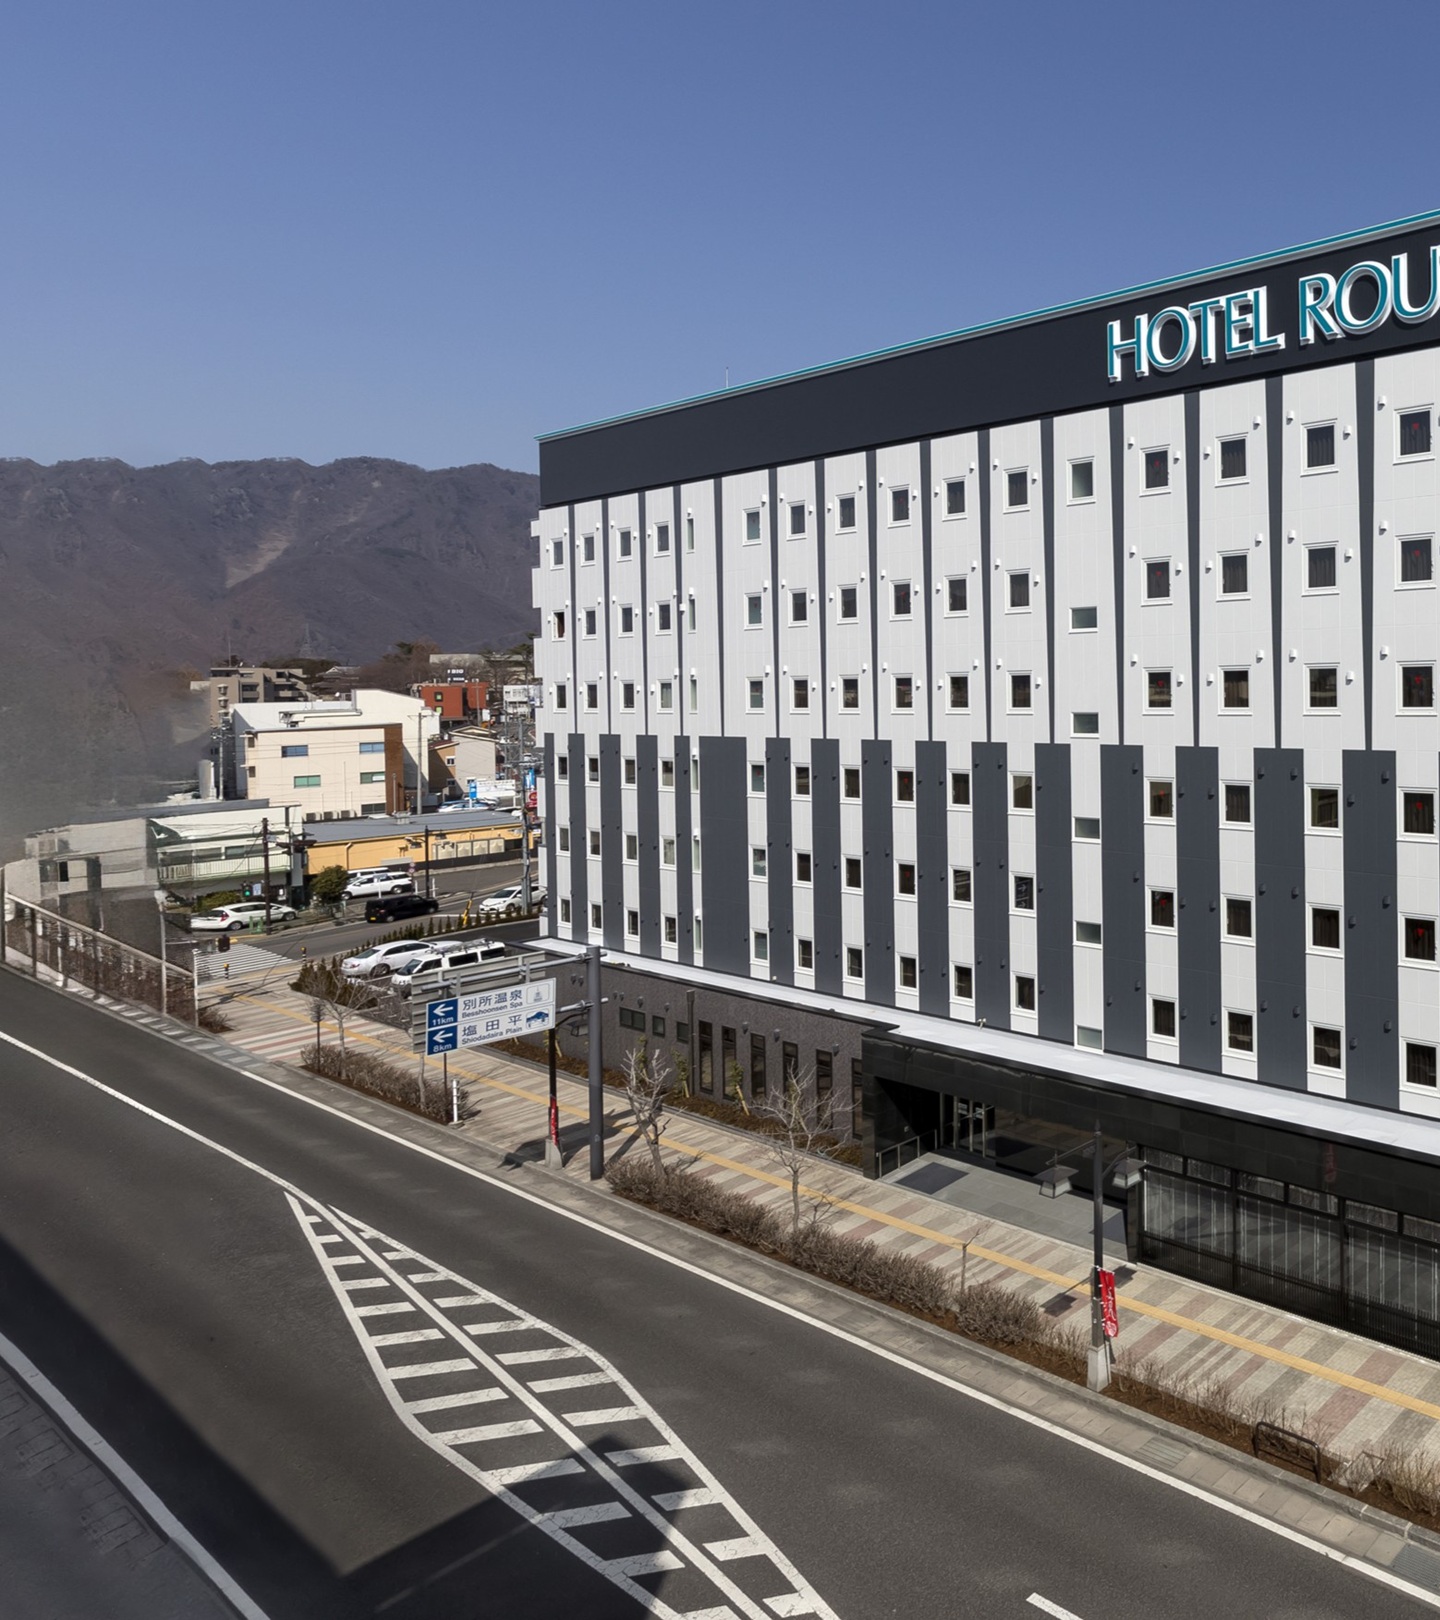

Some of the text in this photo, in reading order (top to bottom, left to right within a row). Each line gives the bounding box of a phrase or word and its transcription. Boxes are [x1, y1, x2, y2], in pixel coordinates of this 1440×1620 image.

[1106, 286, 1286, 383] HOTEL
[461, 1000, 523, 1019] Besshoonsen Spa
[462, 989, 523, 1011] 別所温泉
[432, 1016, 454, 1026] 11km
[461, 1014, 522, 1037] 塩田平
[461, 1026, 523, 1045] Shiodadaira Plain
[433, 1043, 452, 1053] 8km
